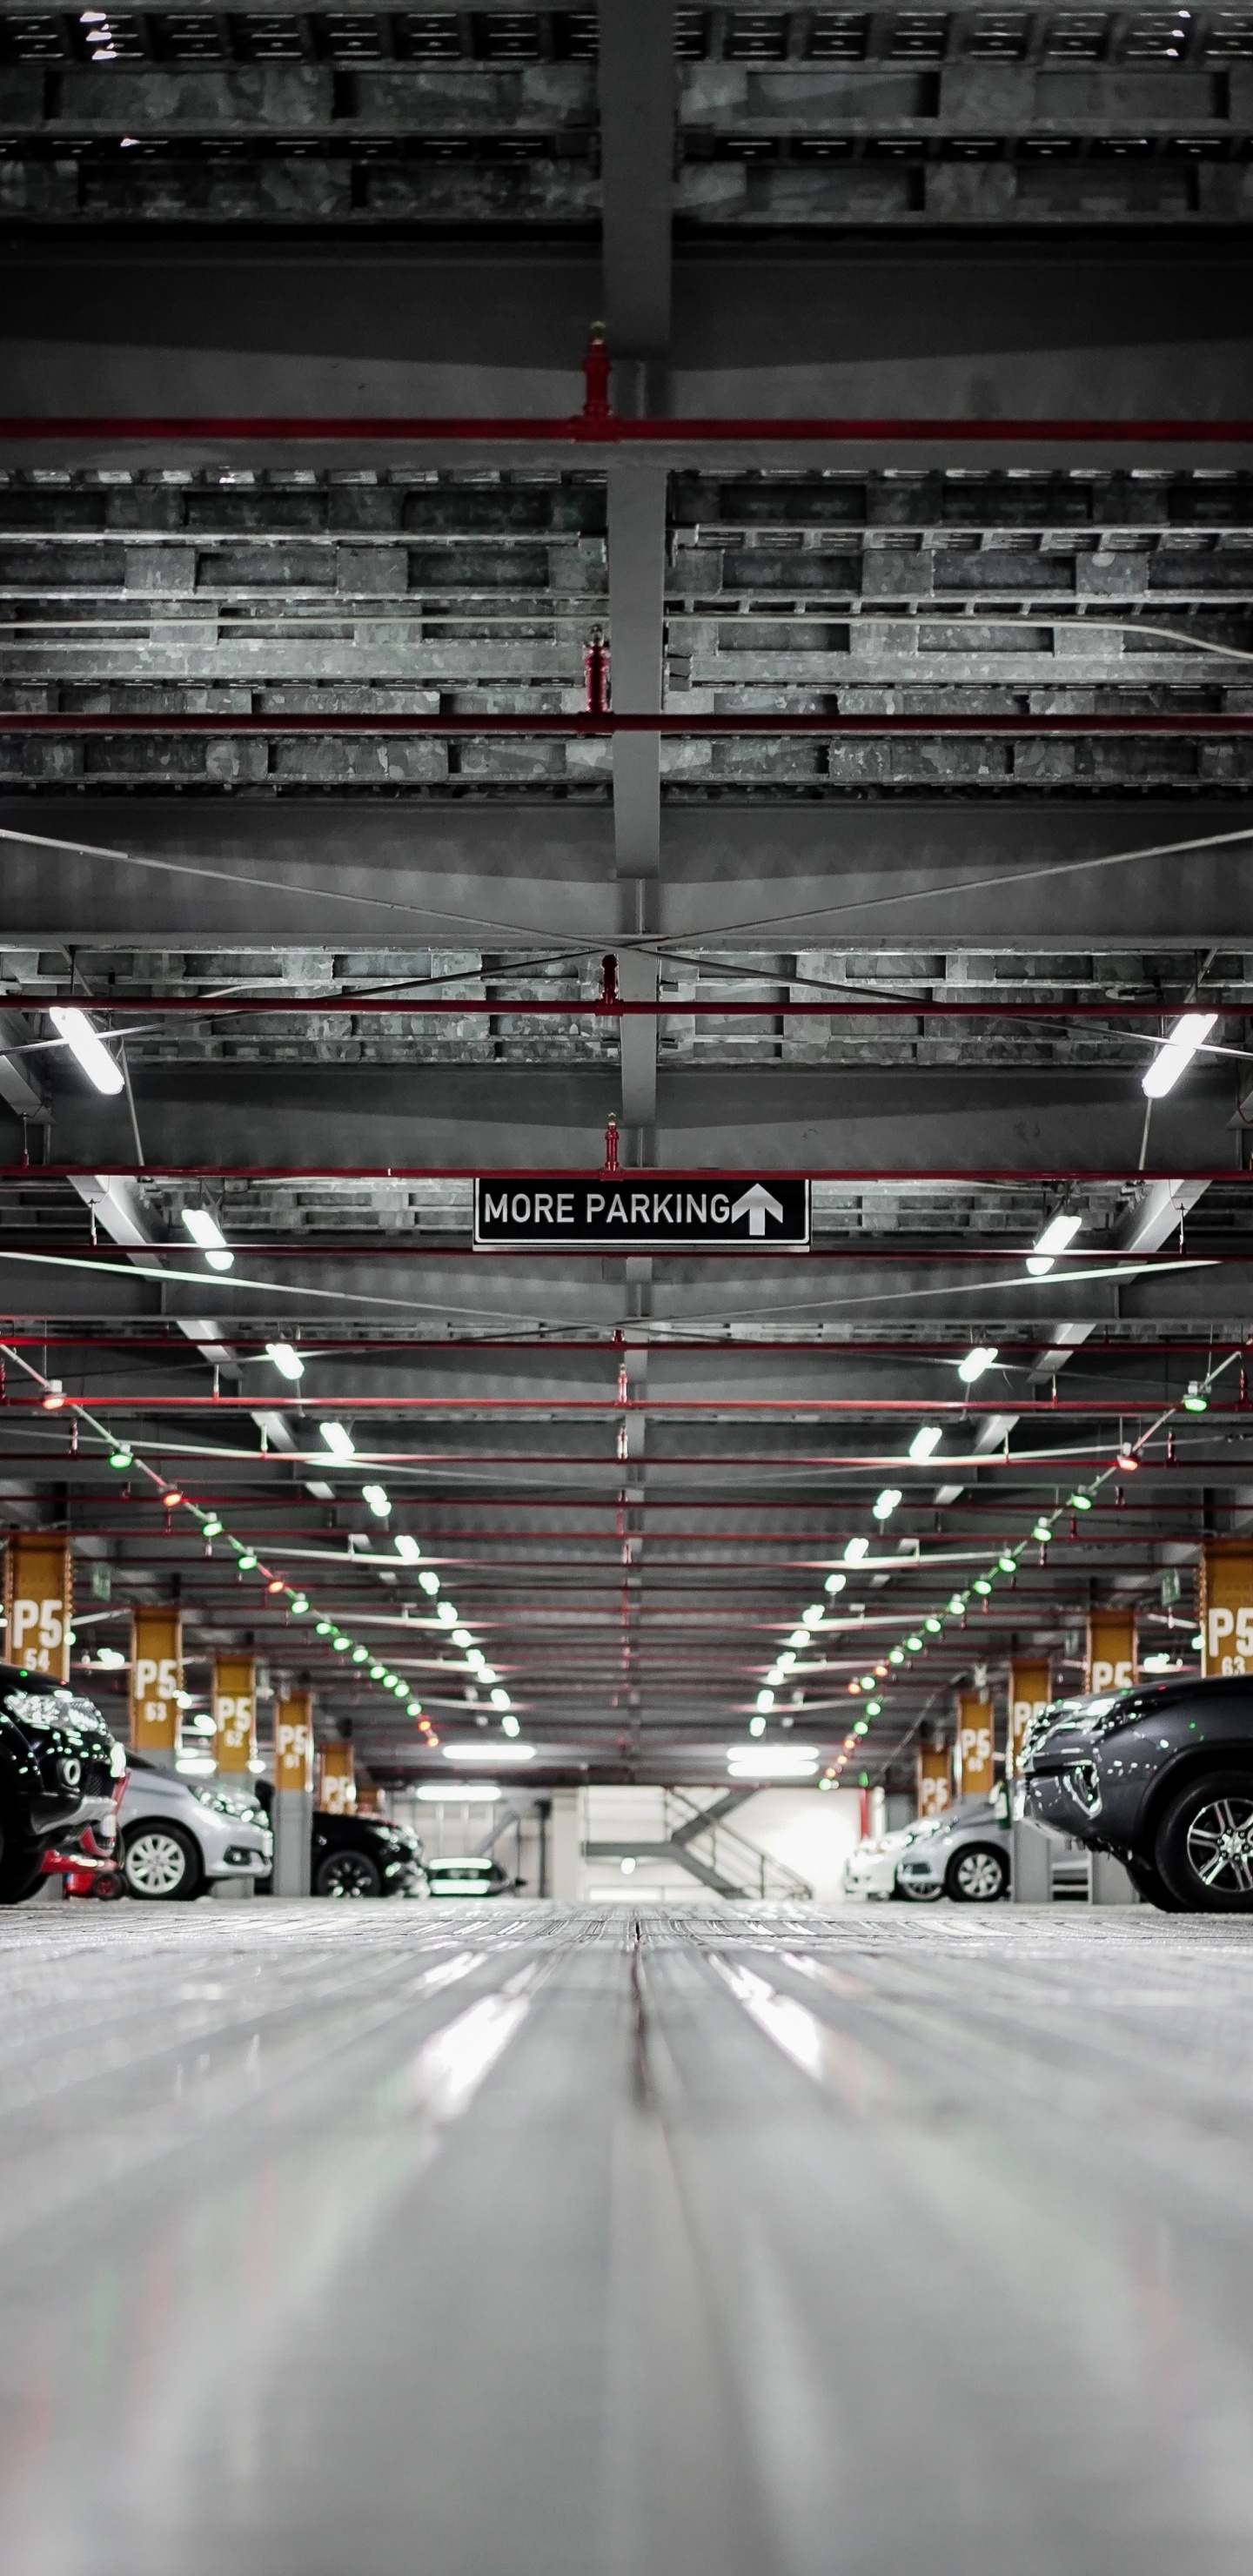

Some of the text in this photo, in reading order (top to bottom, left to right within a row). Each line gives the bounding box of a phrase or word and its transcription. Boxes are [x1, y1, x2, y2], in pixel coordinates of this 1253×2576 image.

[484, 1193, 731, 1223] MORE PARKING
[13, 1599, 63, 1649] P5
[1208, 1607, 1253, 1657] P5
[24, 1647, 50, 1671] 54
[1222, 1655, 1245, 1676] 63
[136, 1659, 177, 1700] P5
[218, 1696, 251, 1732] P5
[277, 1725, 307, 1754] P5
[961, 1728, 990, 1760] P5
[921, 1777, 948, 1805] P5
